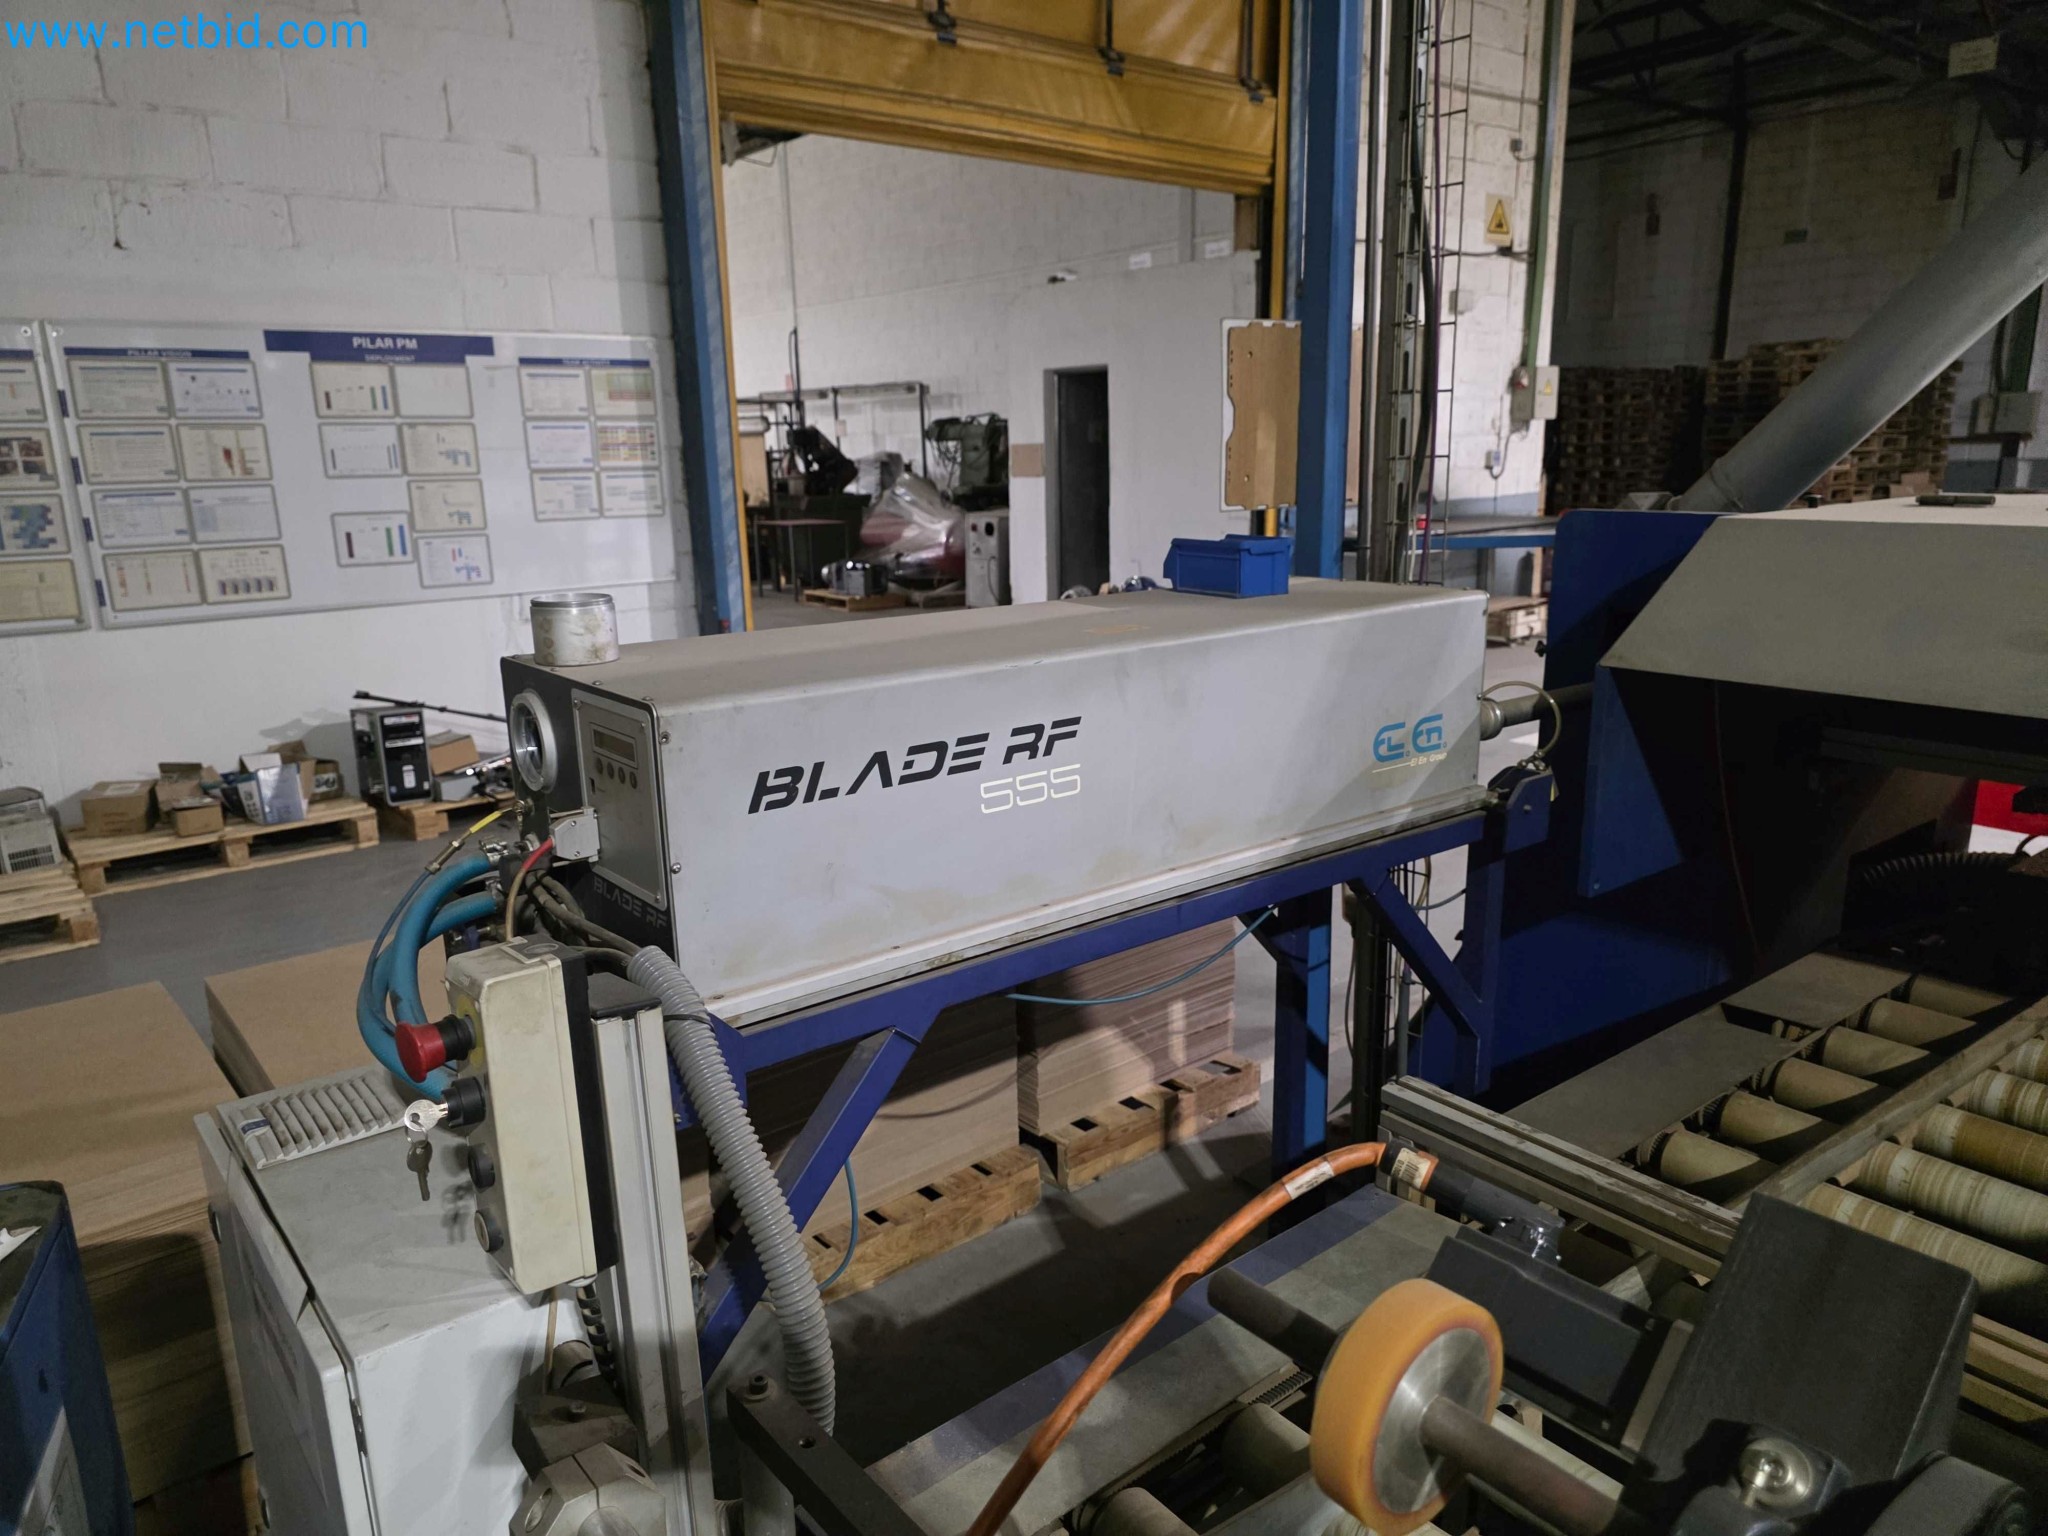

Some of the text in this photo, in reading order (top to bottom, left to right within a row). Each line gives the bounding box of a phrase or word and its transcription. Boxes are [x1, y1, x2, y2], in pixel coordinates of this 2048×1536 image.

[352, 336, 418, 349] PILAR PM
[748, 716, 1082, 815] BLADE RF
[594, 876, 668, 928] BLADE RF
